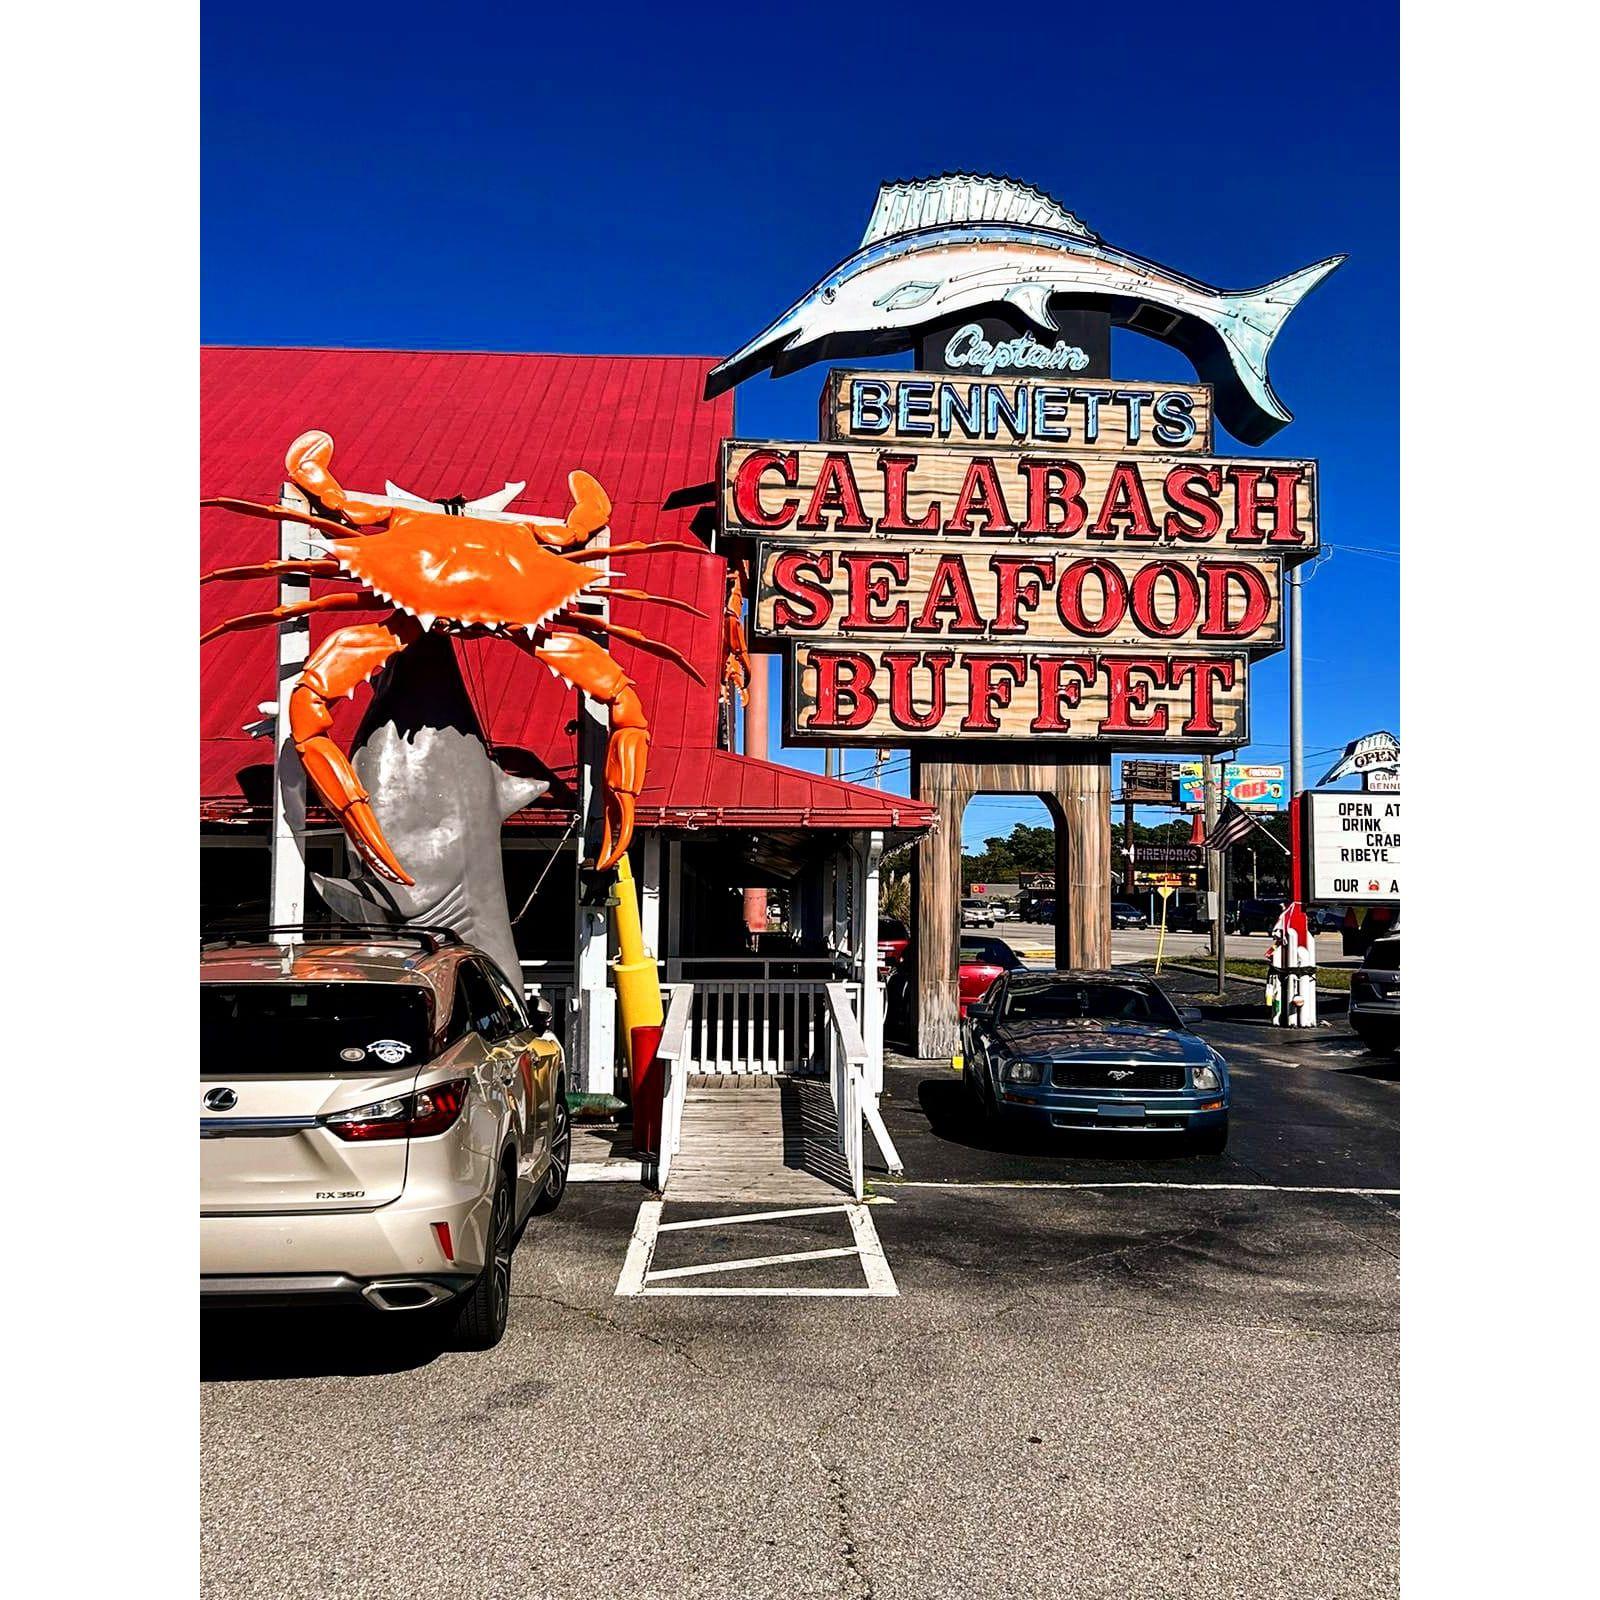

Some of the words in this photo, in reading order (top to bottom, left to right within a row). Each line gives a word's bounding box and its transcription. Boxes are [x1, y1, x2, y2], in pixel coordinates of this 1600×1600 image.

[944, 324, 1089, 375] Captain
[851, 380, 1196, 447] BENNETTS
[734, 451, 1307, 546] CALABASH
[773, 551, 1271, 639] SEAFOOD
[808, 649, 1234, 736] BUFFET
[1354, 751, 1399, 772] OPEN
[1233, 783, 1268, 799] FREE
[1338, 803, 1372, 816] OPEN
[1342, 818, 1381, 831] DRINK
[1136, 848, 1198, 861] FIREWORKS
[1341, 849, 1388, 861] RIBEYE
[1334, 879, 1358, 892] OUR
